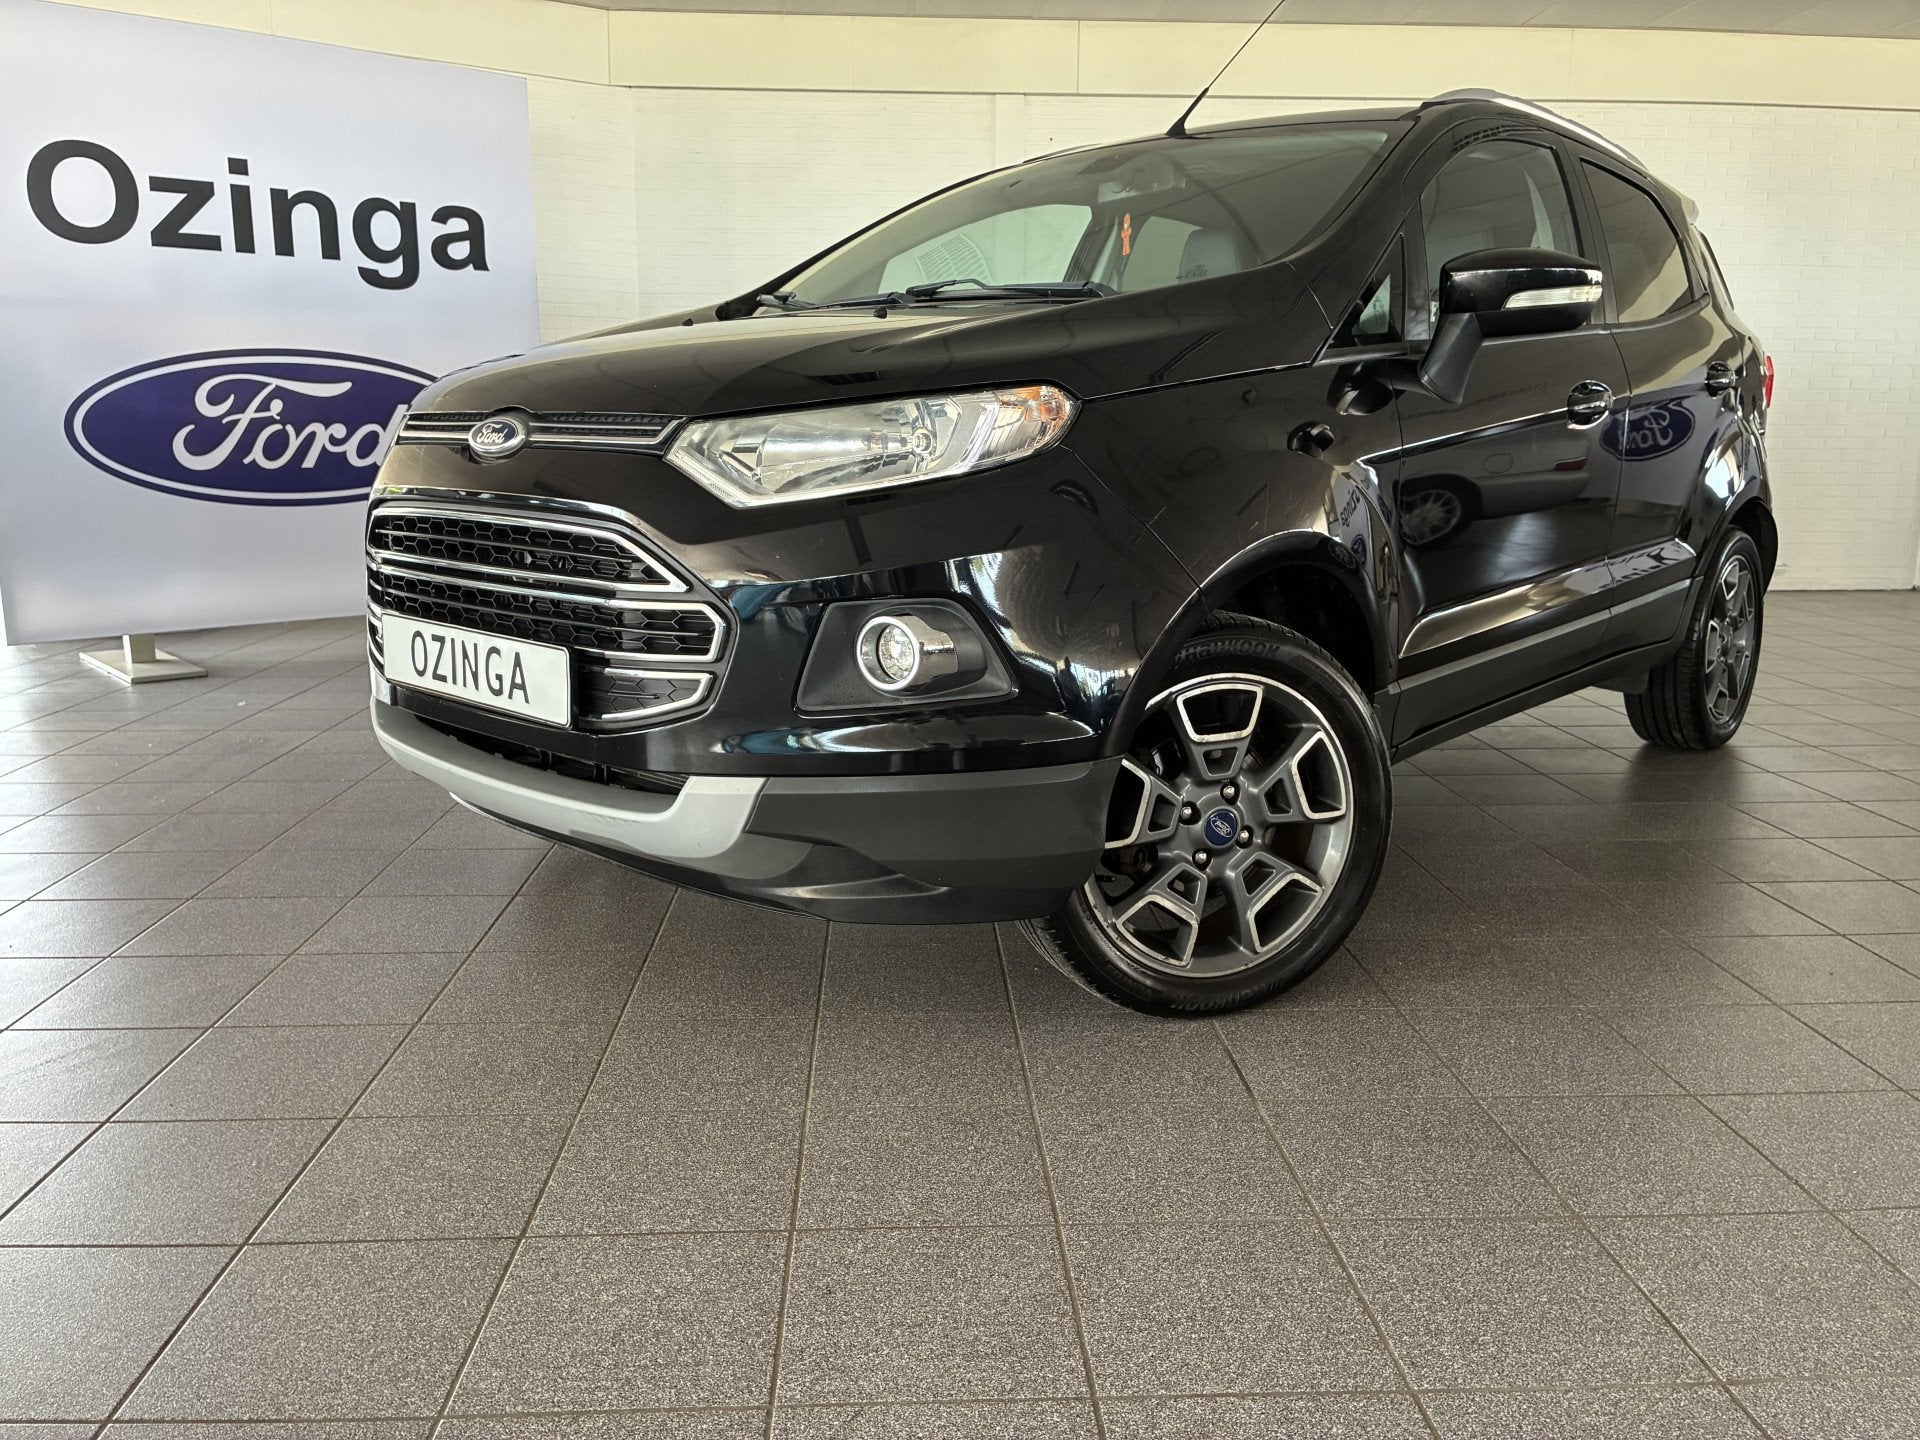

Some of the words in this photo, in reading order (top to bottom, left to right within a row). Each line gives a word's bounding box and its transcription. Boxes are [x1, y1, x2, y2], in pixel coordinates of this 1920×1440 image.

[26, 139, 490, 290] Ozinga
[172, 373, 408, 471] Ford
[477, 423, 508, 444] Ford
[411, 630, 530, 704] OZINGA
